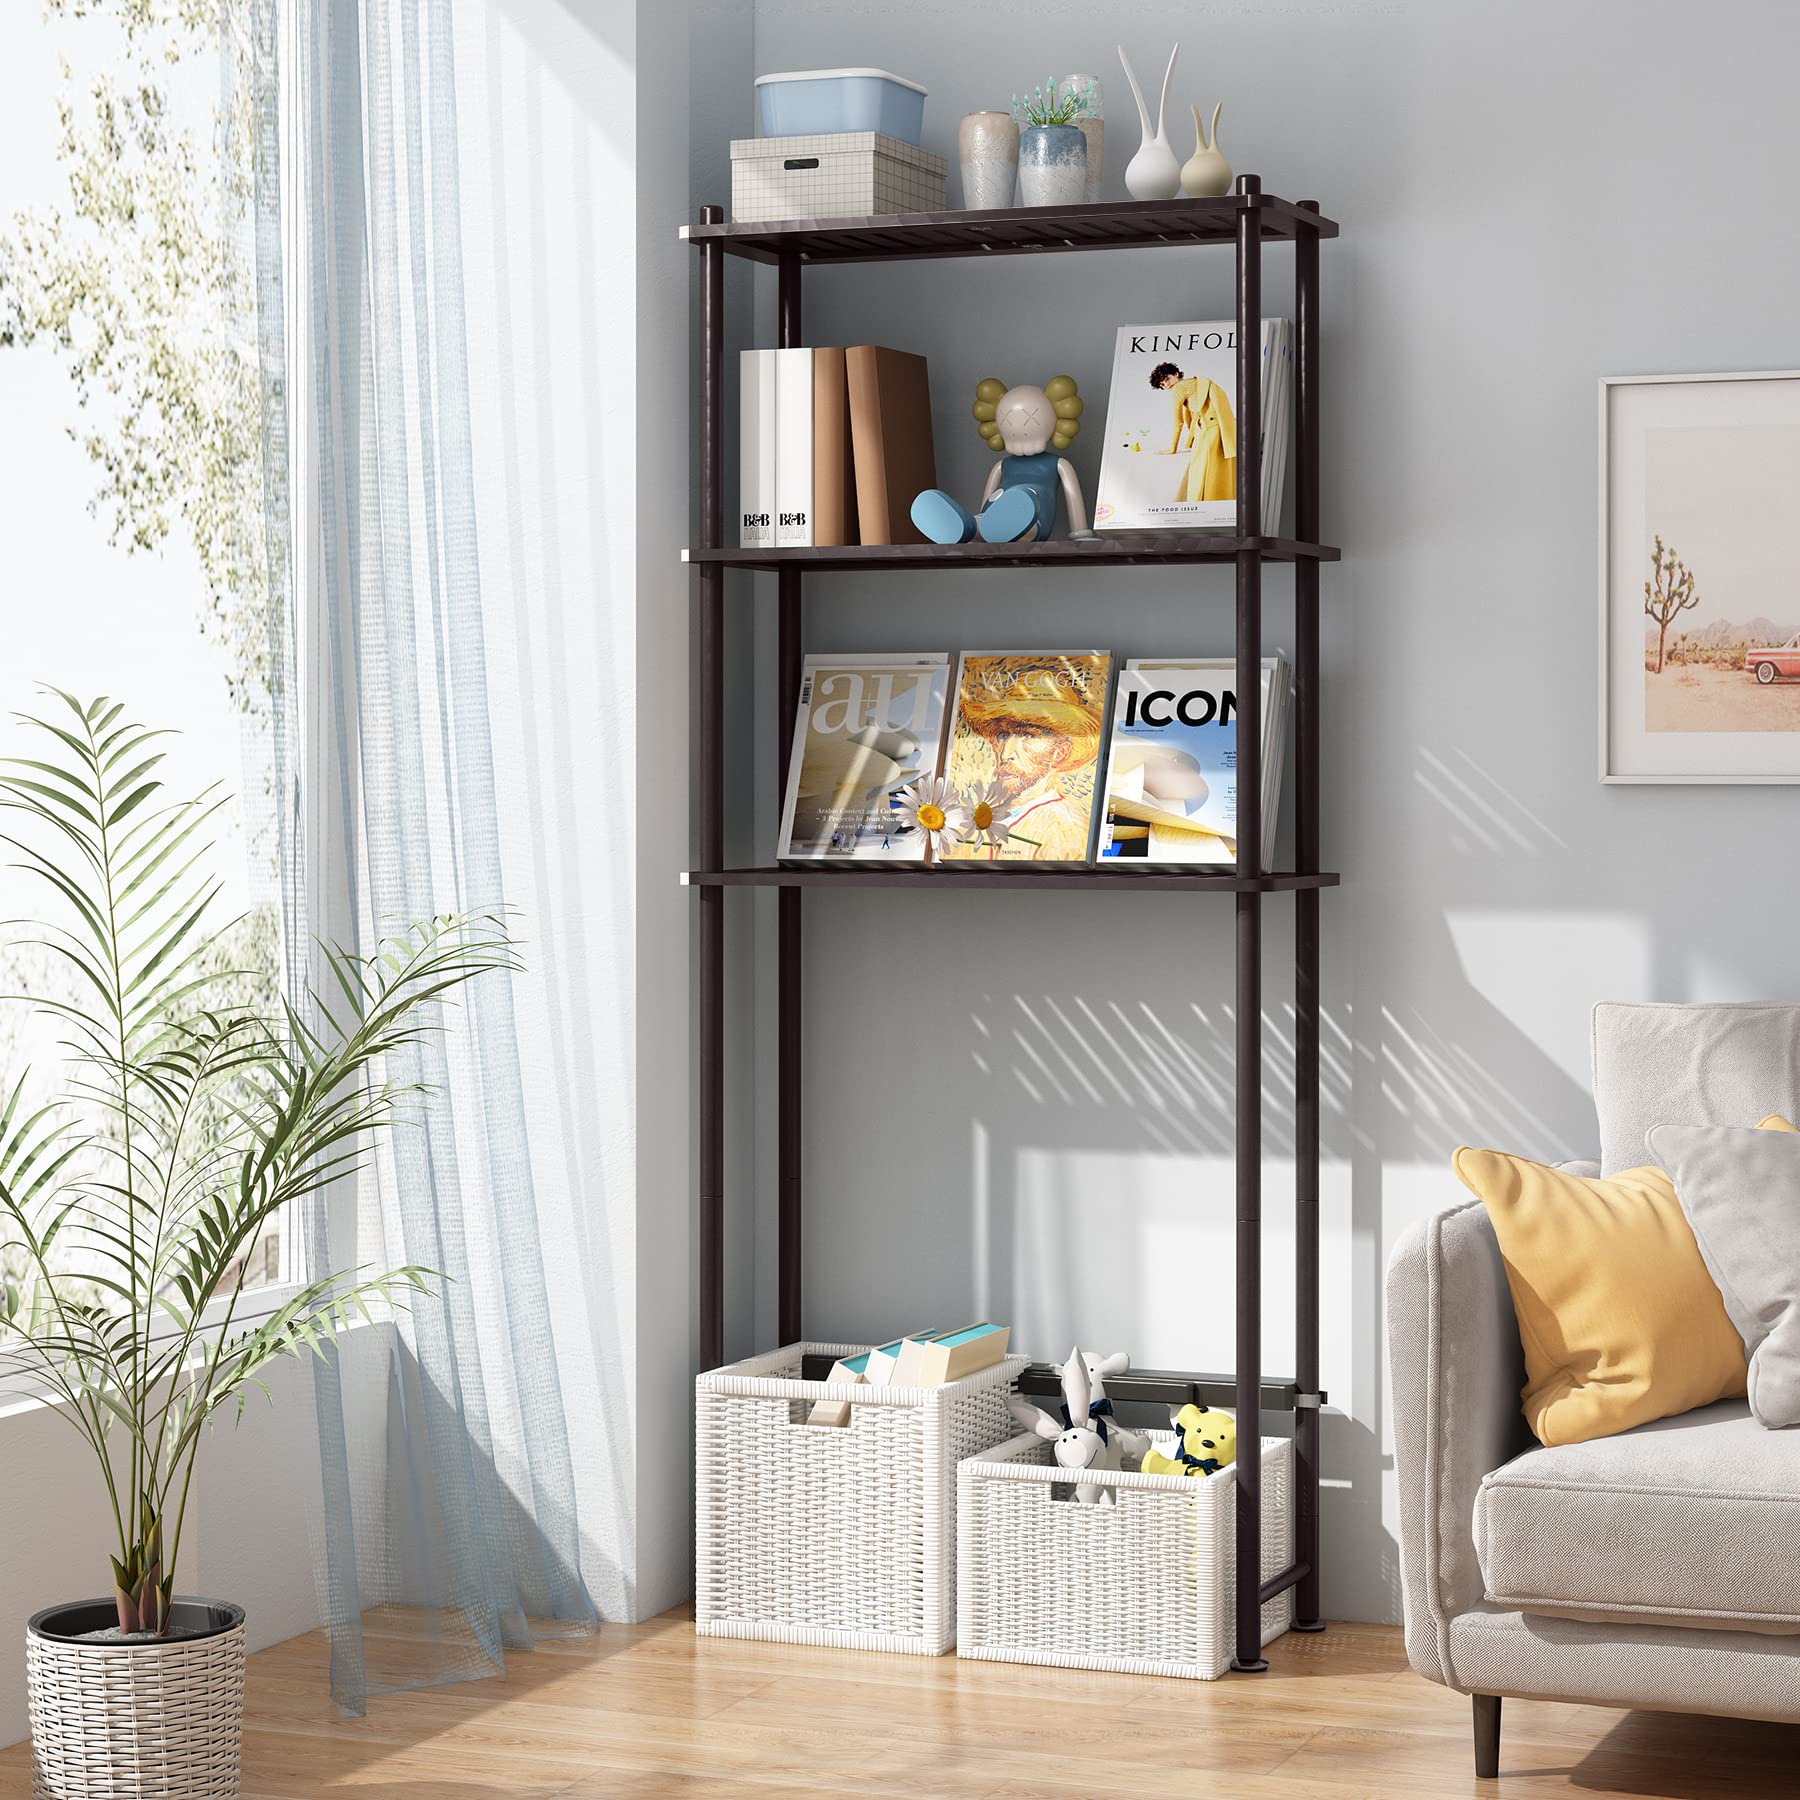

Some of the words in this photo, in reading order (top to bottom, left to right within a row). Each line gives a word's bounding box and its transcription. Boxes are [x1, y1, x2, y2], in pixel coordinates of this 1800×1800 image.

[1129, 332, 1237, 353] KINFOL
[743, 513, 770, 527] B&B
[779, 512, 806, 526] B&B
[981, 671, 1021, 689] VAN
[1024, 670, 1088, 689] GOGH
[829, 815, 854, 823] Projects
[858, 823, 884, 831] Projects
